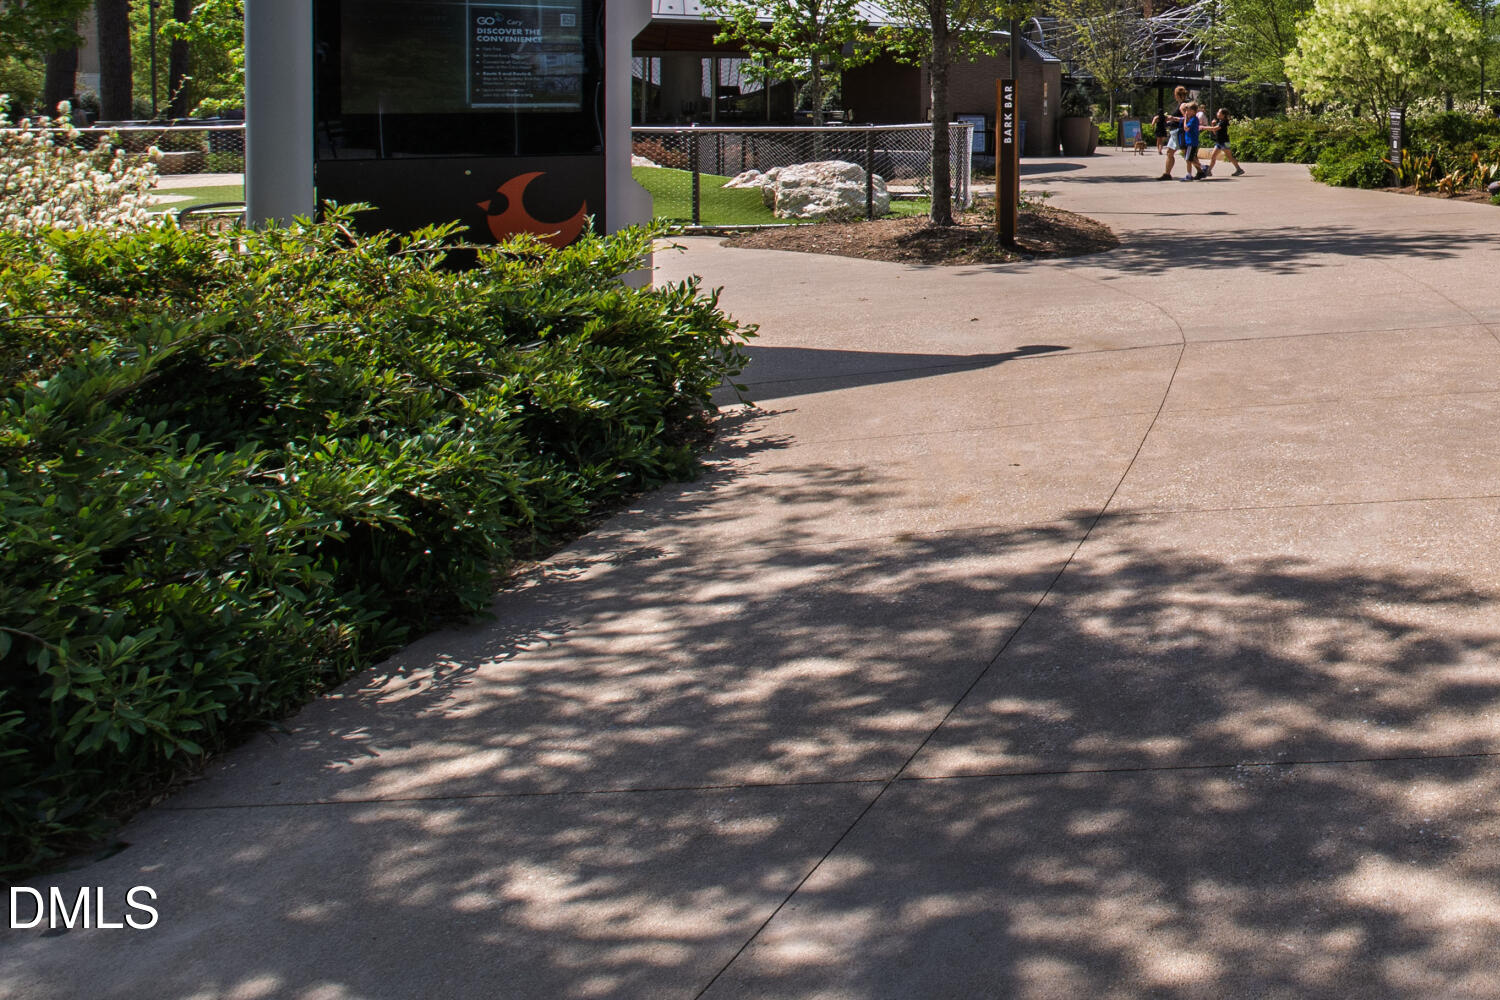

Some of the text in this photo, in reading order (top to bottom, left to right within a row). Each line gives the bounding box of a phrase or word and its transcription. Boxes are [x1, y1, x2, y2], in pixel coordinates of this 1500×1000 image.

[477, 16, 495, 25] GO
[476, 35, 543, 43] CONVENIENCE
[1003, 86, 1013, 144] BARK BAR
